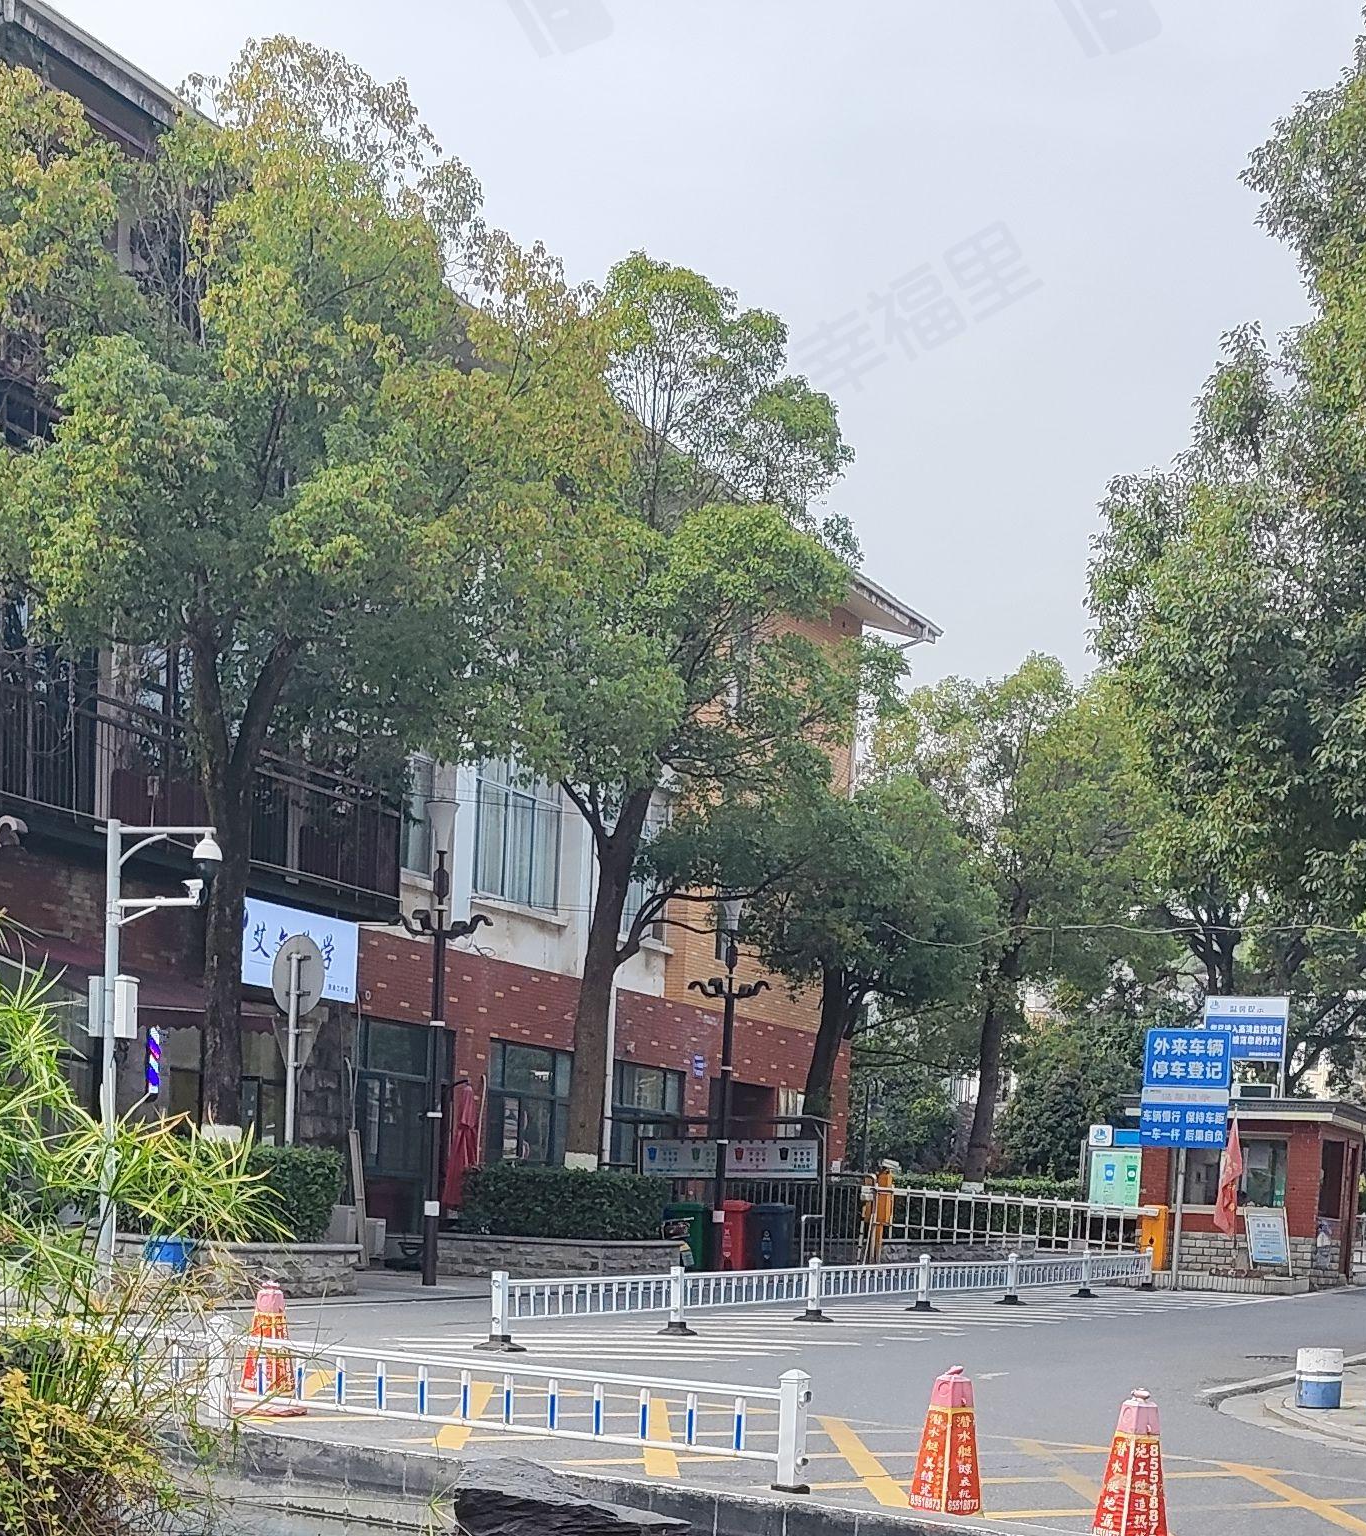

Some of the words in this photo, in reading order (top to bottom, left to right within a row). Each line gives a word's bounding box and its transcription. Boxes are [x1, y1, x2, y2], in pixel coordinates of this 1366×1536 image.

[1153, 1037, 1225, 1057] 外来车辆
[1151, 1060, 1223, 1080] 停车登记
[1185, 1110, 1225, 1125] 保持车距
[1184, 1129, 1224, 1143] 后果自负
